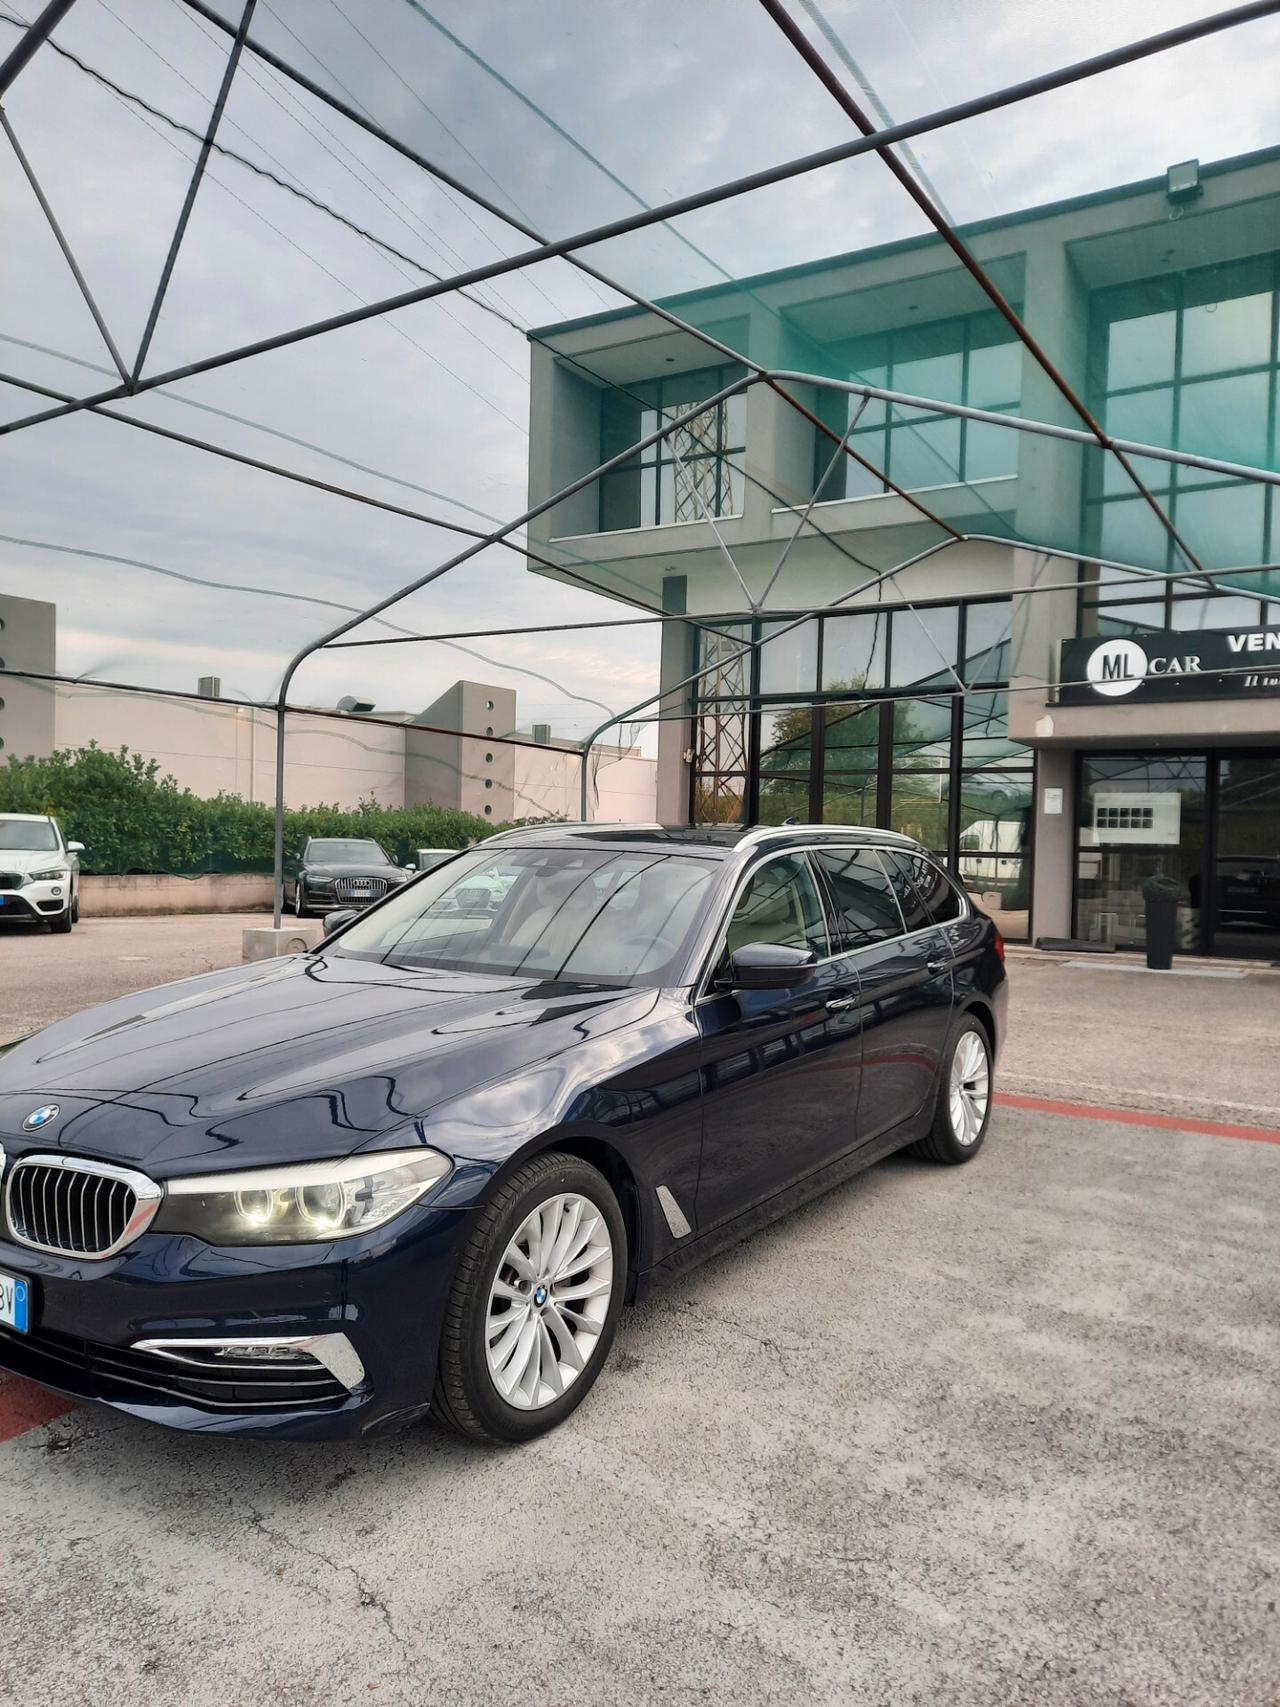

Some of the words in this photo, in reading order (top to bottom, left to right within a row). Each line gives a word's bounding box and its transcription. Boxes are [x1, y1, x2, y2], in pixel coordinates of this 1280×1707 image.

[1227, 633, 1280, 653] VEN
[1102, 653, 1134, 680] ML
[1150, 655, 1202, 674] CAR
